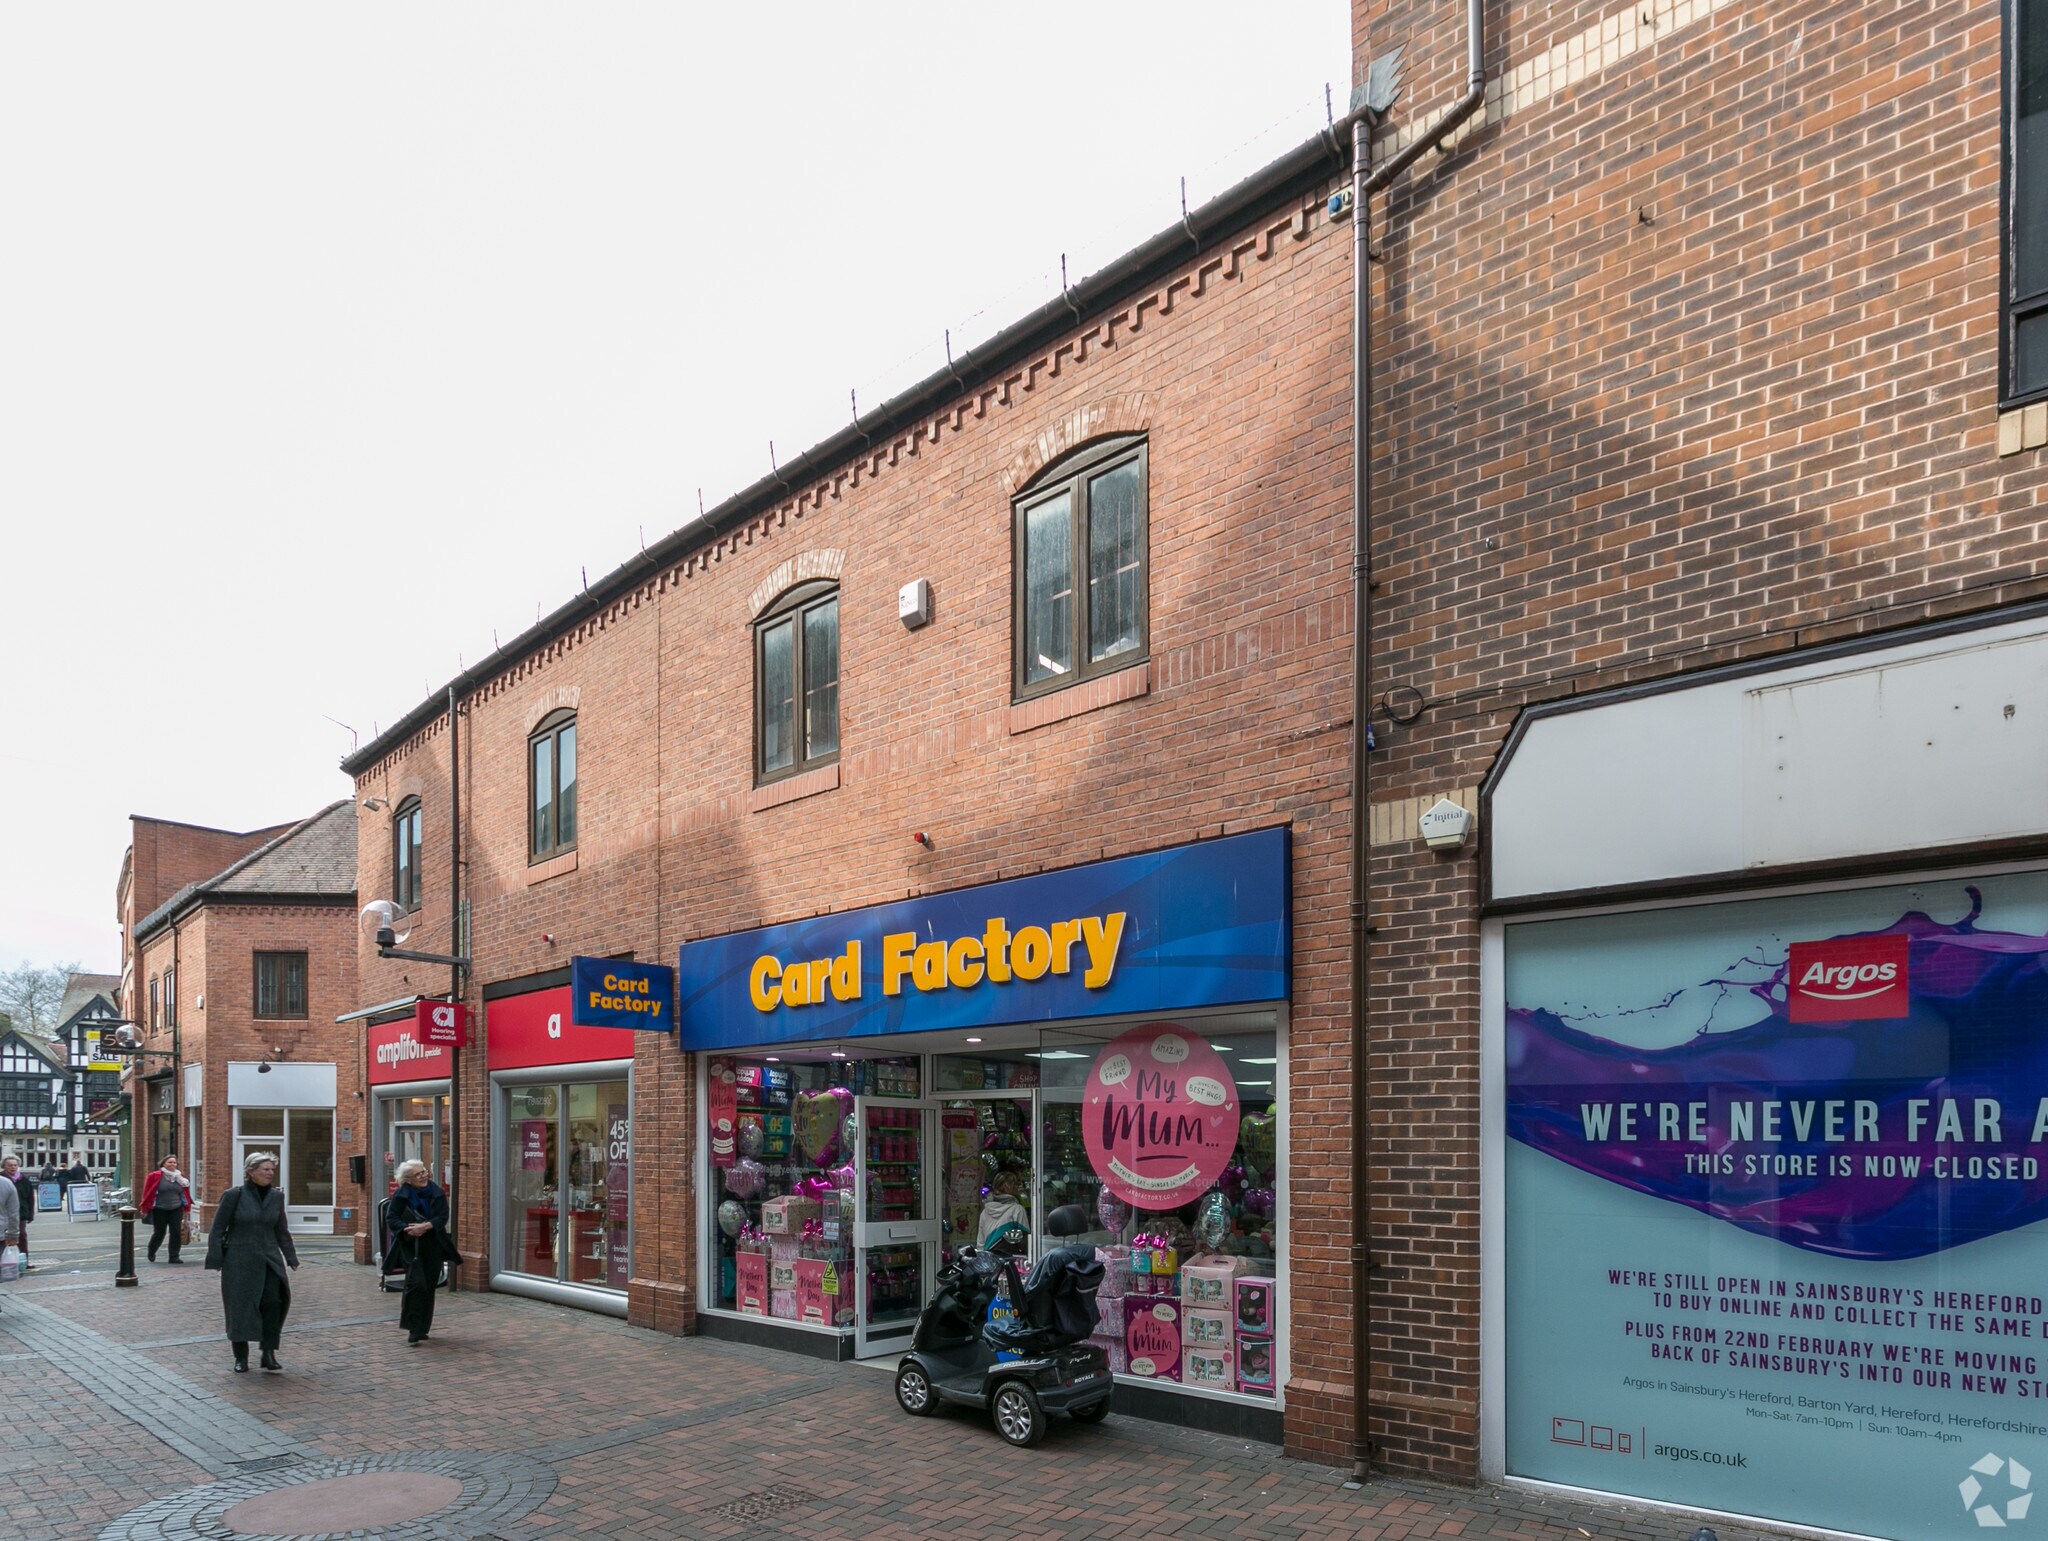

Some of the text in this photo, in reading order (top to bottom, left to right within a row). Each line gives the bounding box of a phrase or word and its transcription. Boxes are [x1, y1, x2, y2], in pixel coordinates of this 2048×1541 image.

[1434, 810, 1463, 822] Initial
[749, 911, 1127, 1012] Card Factory
[603, 974, 649, 994] Card
[1799, 961, 1898, 990] Argos
[589, 991, 662, 1017] Factory
[1136, 1069, 1178, 1104] My
[1581, 1101, 1707, 1142] WE'RE
[1730, 1100, 1880, 1142] NEVER
[1907, 1098, 2002, 1142] FAR
[529, 1131, 540, 1139] Price
[1684, 1154, 2038, 1180] THIS STORE IS NOW CLOSED
[613, 1254, 629, 1263] hearin
[1608, 1269, 2042, 1315] WE'RE STILL OPEN IN SAINSBURY'S HEREFORD
[1654, 1292, 1672, 1308] TO
[1680, 1295, 1712, 1311] BUY
[1720, 1297, 1782, 1317] ONLINE
[1790, 1302, 1825, 1320] AND
[1835, 1305, 1917, 1328] COLLECT
[1928, 1313, 1964, 1332] THE
[1974, 1316, 2032, 1338] SAME
[1625, 1321, 2036, 1375] PLUS FROM 22ND FEBRUARY WE'RE MOVING
[1074, 1373, 1095, 1384] ROYALE
[1651, 1343, 1694, 1362] BACK
[1701, 1348, 1720, 1365] OF
[1729, 1350, 1850, 1378] SAINSBURY'S
[1859, 1363, 1903, 1384] INTO
[1913, 1369, 1951, 1389] OUR
[1962, 1373, 2007, 1395] NEW
[1623, 1375, 1655, 1390] Argos
[1657, 1379, 1667, 1390] in
[1670, 1380, 1735, 1400] Sainsbury's
[1739, 1389, 1795, 1407] Hereford,
[1798, 1396, 1841, 1411] Barton
[1844, 1400, 1878, 1417] Yard,
[1881, 1406, 1944, 1425] Hereford,
[1868, 1423, 1893, 1435] Sun:
[1654, 1443, 1748, 1468] argos.co.uk
